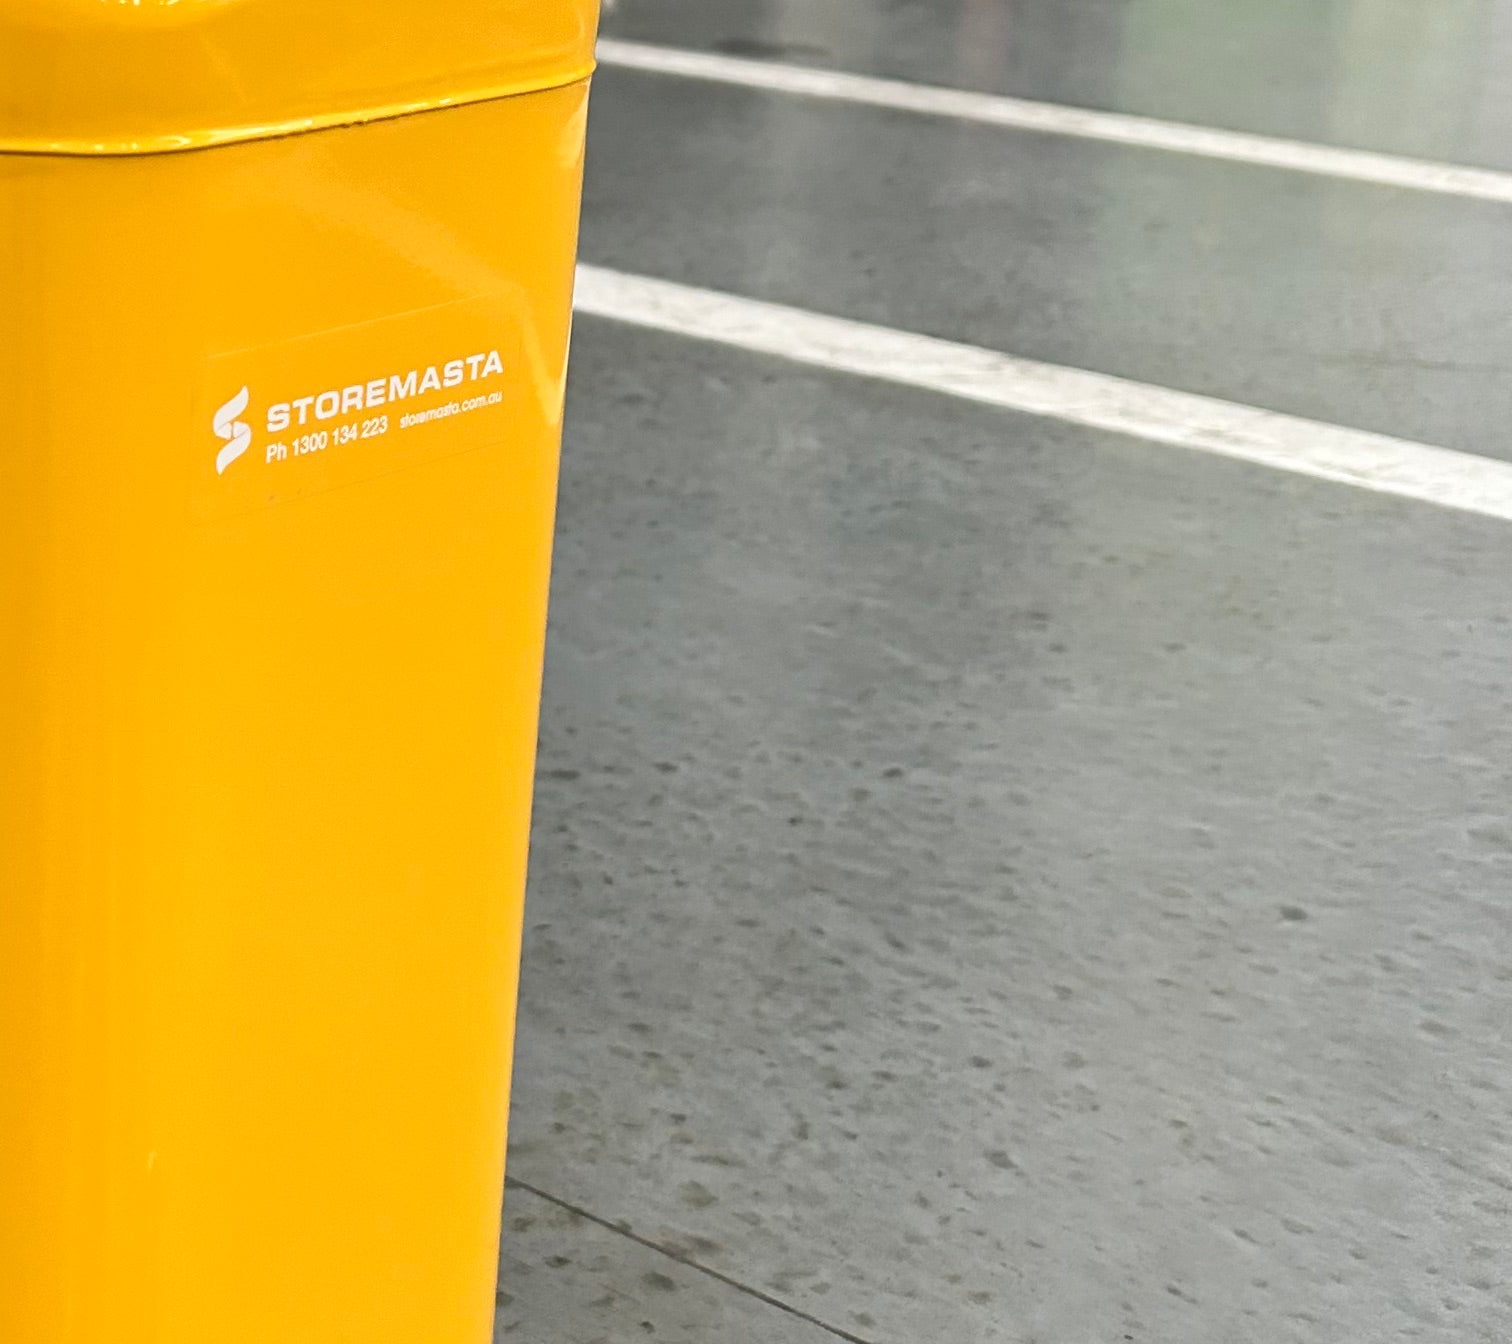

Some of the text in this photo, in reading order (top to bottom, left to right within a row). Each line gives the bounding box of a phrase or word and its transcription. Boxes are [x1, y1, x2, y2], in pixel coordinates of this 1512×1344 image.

[265, 350, 504, 433] STOREMASTA
[265, 389, 503, 464] Ph 1300 134 223 storemasta.com.au
